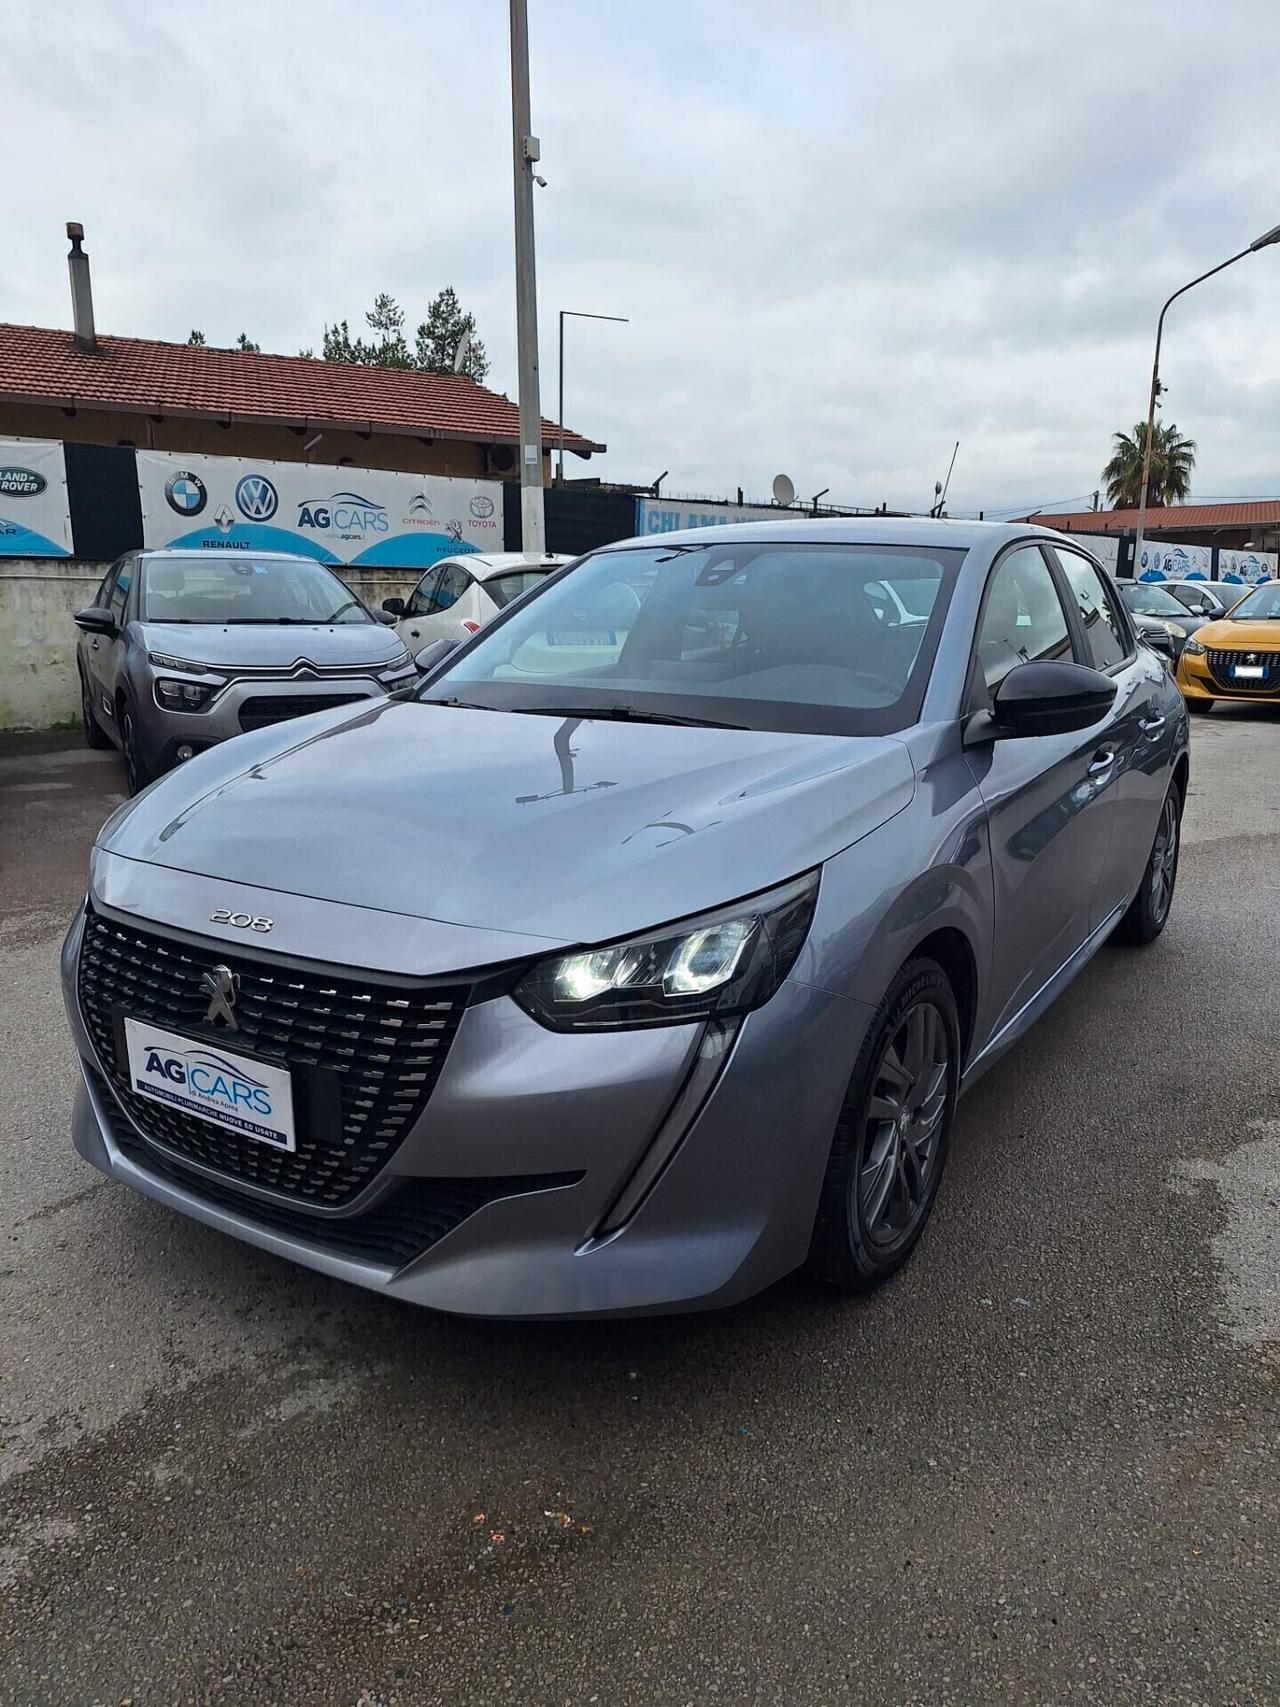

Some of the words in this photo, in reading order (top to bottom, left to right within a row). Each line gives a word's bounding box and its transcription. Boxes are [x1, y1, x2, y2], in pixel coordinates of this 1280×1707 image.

[0, 471, 28, 482] LAND
[168, 472, 204, 488] BMW
[1, 481, 38, 492] ROVER
[468, 519, 497, 529] TOYOTA
[203, 540, 251, 550] RENAULT
[209, 908, 275, 934] 208
[198, 1093, 220, 1106] Andrea
[144, 1084, 177, 1102] AUTOMOBILI
[177, 1097, 219, 1118] PLURIMARCHE
[219, 1112, 244, 1127] NUOVE
[254, 1125, 279, 1140] USATE
